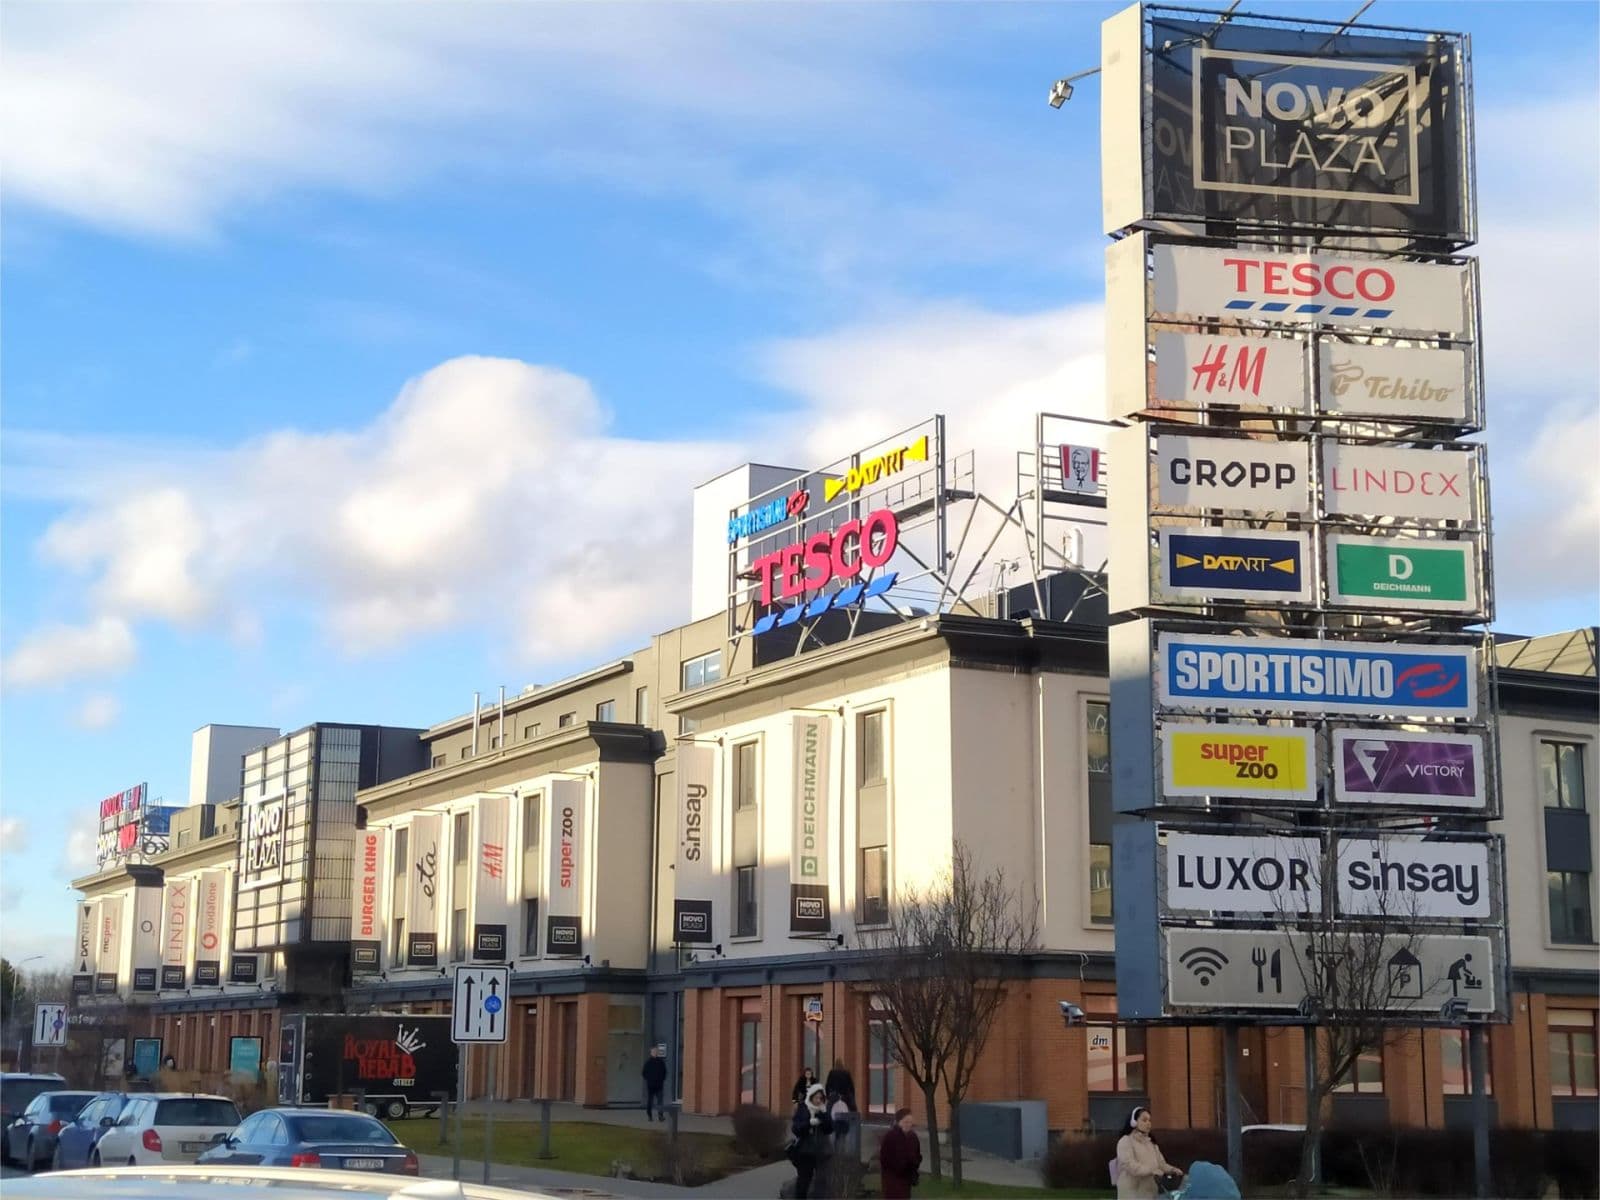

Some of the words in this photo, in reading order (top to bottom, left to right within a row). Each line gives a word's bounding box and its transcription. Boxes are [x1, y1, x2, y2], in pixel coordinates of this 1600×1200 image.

[1224, 77, 1386, 124] NOVO
[1224, 126, 1386, 175] PLAZA
[1223, 258, 1396, 302] TESCO
[1192, 344, 1268, 397] H&M
[1364, 375, 1454, 403] Tchibo
[846, 447, 909, 492] DATART
[1170, 457, 1297, 490] CROPP
[1331, 466, 1461, 497] LINDEX
[753, 509, 898, 606] TESCO
[1203, 554, 1271, 573] DATART
[1388, 555, 1413, 580] D
[1373, 582, 1432, 594] DEICHMANN
[1175, 651, 1394, 699] SPORTISIMO
[1200, 740, 1269, 764] super
[1236, 760, 1279, 780] zoo
[803, 723, 818, 850] DEICHMANN
[1405, 764, 1465, 778] VICTORY
[250, 806, 282, 838] NOVO
[562, 807, 574, 837] zoo
[681, 783, 708, 862] sinsay
[249, 838, 280, 872] PLAZA
[364, 834, 377, 873] KING
[561, 839, 575, 889] super
[416, 841, 437, 910] eta
[1177, 855, 1310, 891] LUXOR
[1347, 850, 1480, 906] sinsay
[168, 884, 187, 963] LINDEX
[206, 882, 217, 930] vodafone
[361, 875, 376, 936] BURGER
[800, 908, 821, 916] PLAZA
[343, 1033, 400, 1059] ROYAL
[1092, 1035, 1108, 1046] dm
[359, 1053, 417, 1079] KEBAB
